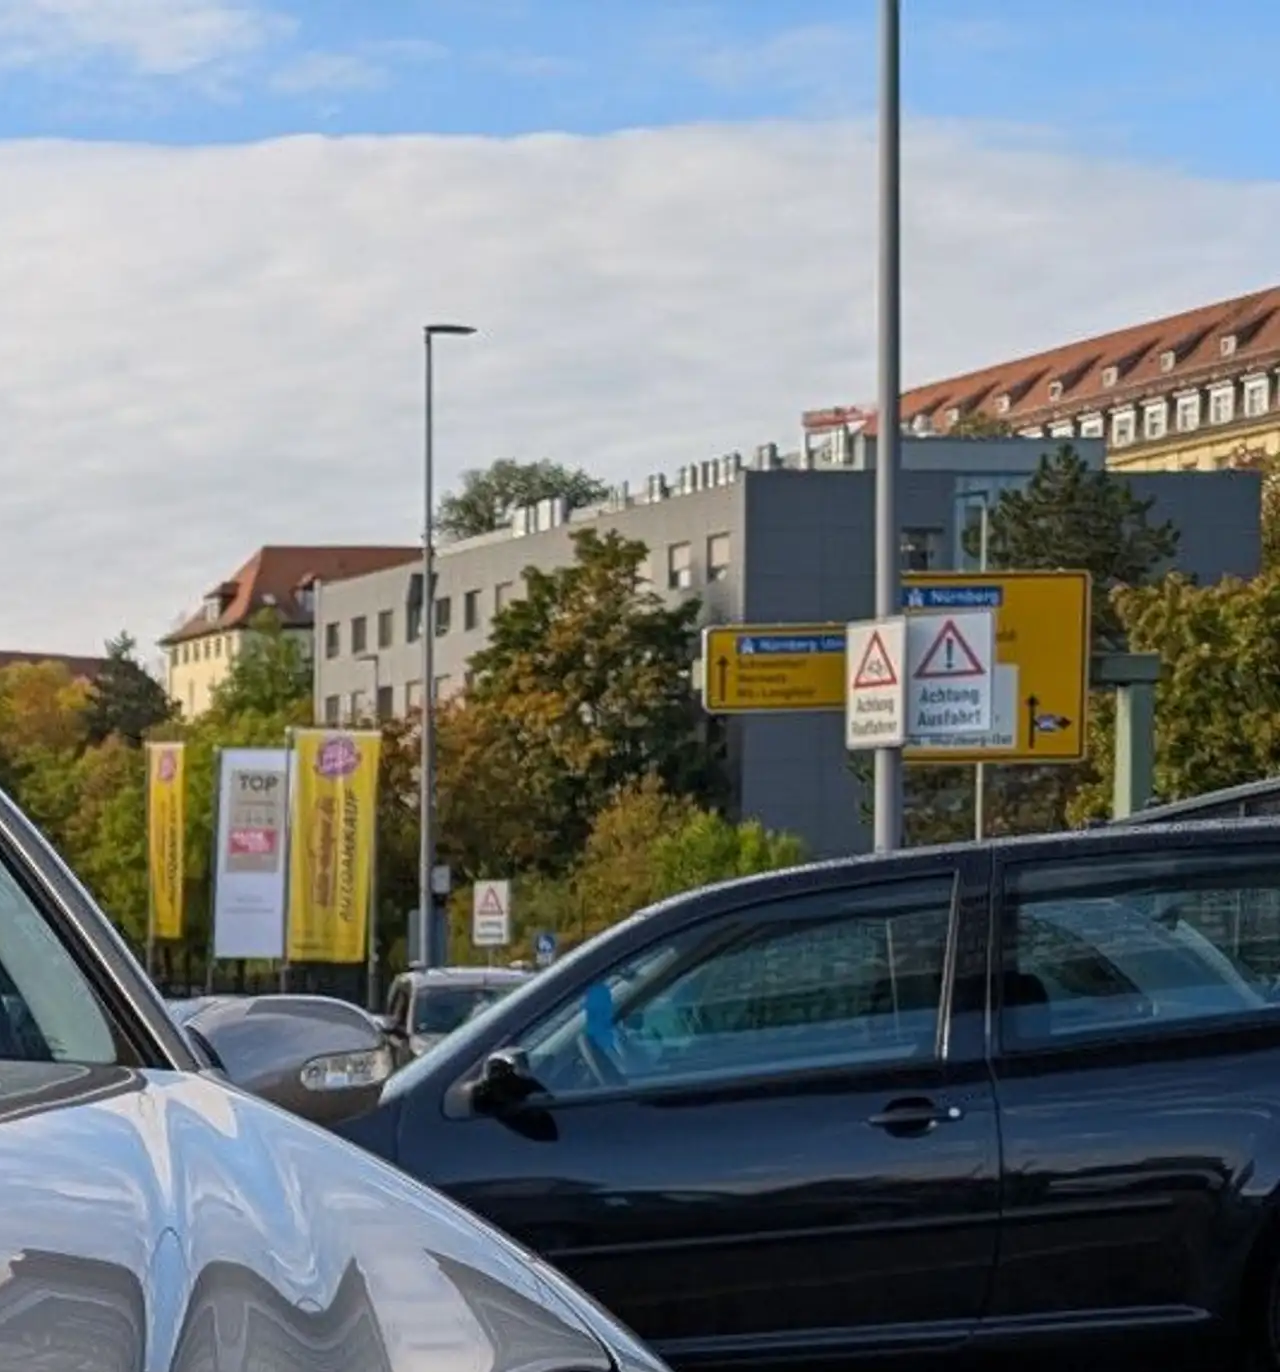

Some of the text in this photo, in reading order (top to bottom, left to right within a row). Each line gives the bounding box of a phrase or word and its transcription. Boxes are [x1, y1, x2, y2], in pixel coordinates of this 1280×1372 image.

[919, 686, 980, 706] Achtung
[917, 709, 981, 727] Ausfahrt
[240, 775, 277, 792] TOP
